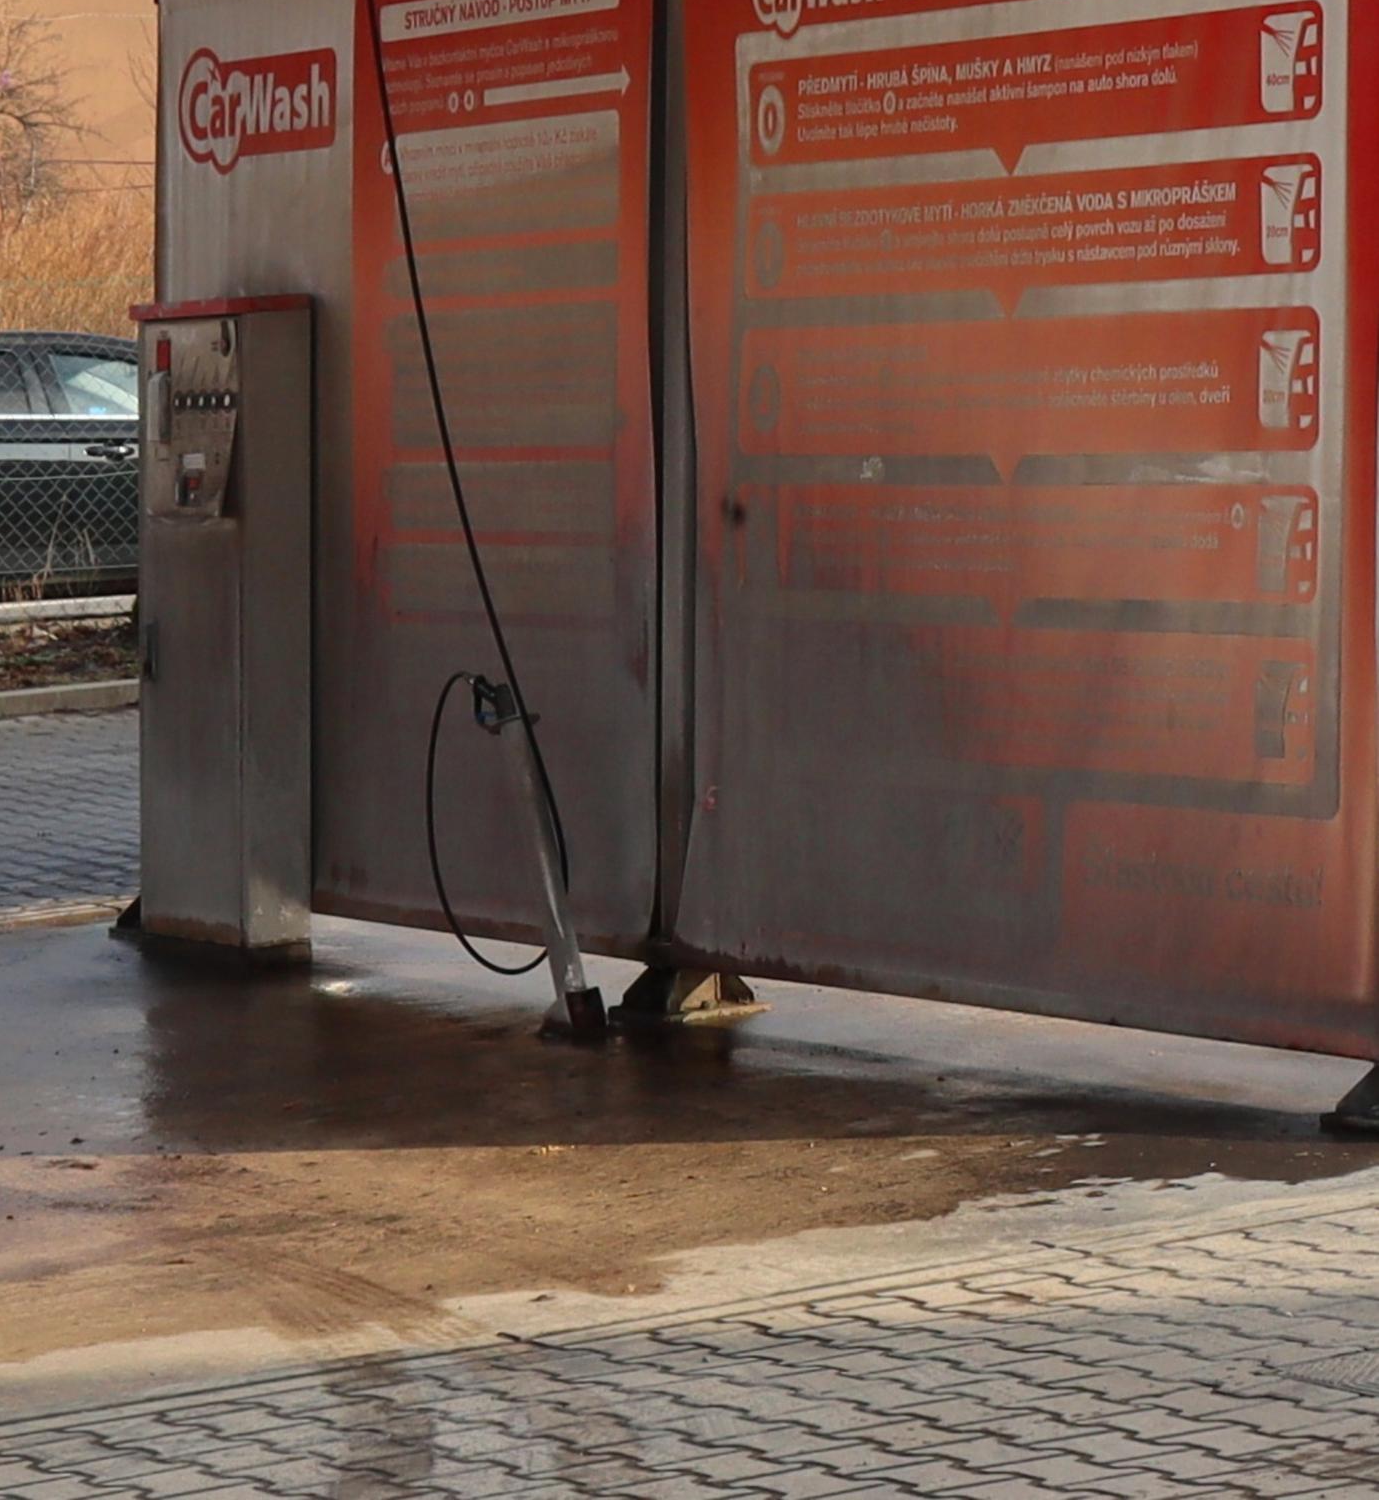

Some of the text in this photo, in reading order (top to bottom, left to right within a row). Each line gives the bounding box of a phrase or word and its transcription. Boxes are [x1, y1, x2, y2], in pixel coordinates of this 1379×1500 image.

[404, 0, 457, 31] STRUČNÝ
[798, 70, 858, 96] PŘEDMYTÍ
[867, 65, 909, 90] HRUBÁ
[911, 62, 953, 86] ŠPÍNA,
[955, 56, 999, 81] MUŠKY
[1002, 58, 1013, 76] A
[1017, 54, 1052, 75] HMYZ
[1115, 71, 1149, 90] shora
[183, 58, 331, 156] CarWash
[961, 195, 1004, 219] HORKÁ
[1076, 192, 1114, 212] VODA
[1117, 192, 1127, 209] S
[1130, 181, 1236, 209] MIKROPRÁŠKEM
